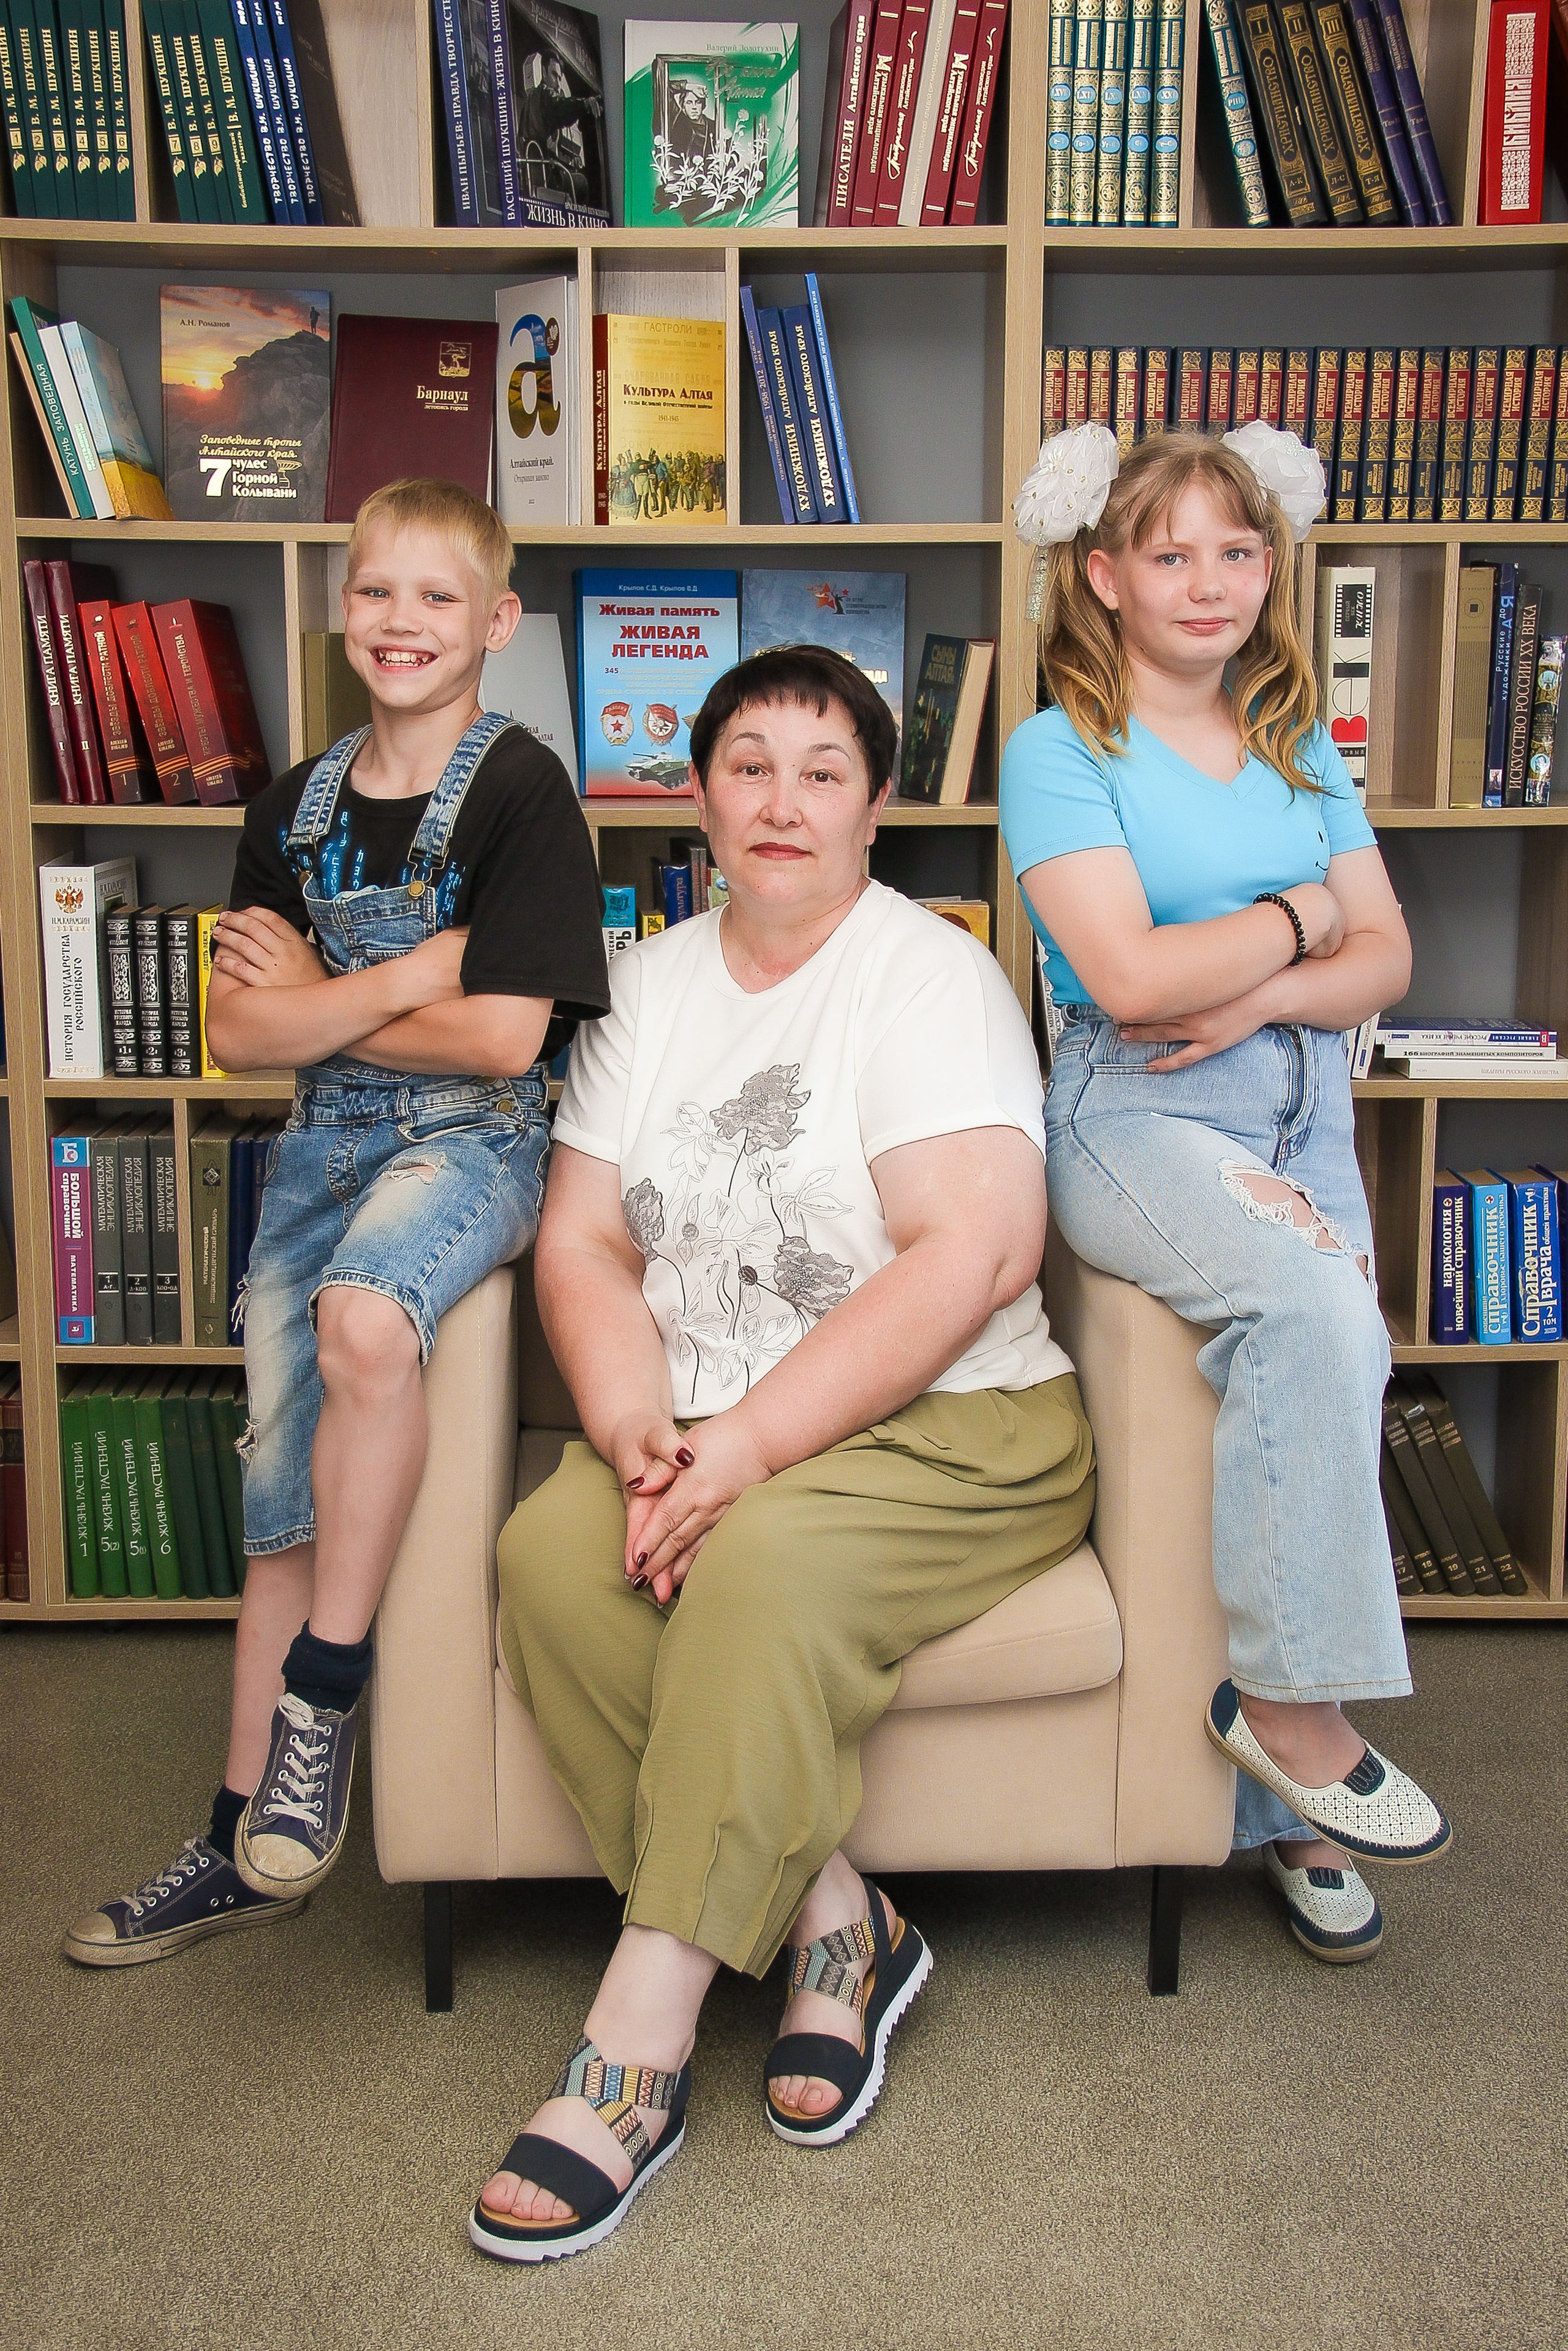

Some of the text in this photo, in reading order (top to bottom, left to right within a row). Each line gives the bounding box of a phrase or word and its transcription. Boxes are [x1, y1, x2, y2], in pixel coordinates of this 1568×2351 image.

[493, 33, 502, 43] В
[1326, 18, 1341, 33] III
[492, 45, 506, 91] ЖИЗНЬ
[706, 43, 779, 53] Валерий Золотухин
[19, 28, 40, 125] В. М. ШУКШИН
[41, 28, 62, 126] В. М. ШУКШИН
[68, 29, 85, 126] В. М. ШУКШИН
[246, 57, 265, 110] ШУКШИНА
[450, 71, 462, 119] ПРАВДА
[497, 91, 510, 159] ШУКШИН:
[835, 15, 866, 208] ПИСАТЕЛИ Алтайского края
[455, 121, 468, 175] ПЫРЬЕВ:
[263, 137, 284, 204] ТВОРЧЕСТВО
[502, 160, 516, 221] ВАСИЛИЙ
[1289, 176, 1303, 187] А-К
[1331, 174, 1346, 185] Л-С
[1365, 175, 1381, 186] Т-Я
[461, 179, 471, 211] ИВАН
[526, 203, 566, 227] ЖИЗНЬ
[567, 212, 576, 228] В
[198, 319, 231, 328] Романов
[644, 322, 692, 334] ГАСТРОЛИ
[416, 385, 469, 404] Барнаул
[623, 383, 713, 401] КУЛЬТУРА АЛТАЯ
[756, 369, 771, 410] 1958-2012
[1044, 371, 1055, 418] ВСЕМИРНАЯ
[1053, 376, 1062, 412] ИСТОРИЯ
[1066, 372, 1077, 418] ВСЕМИРНАЯ
[1076, 377, 1086, 412] ИСТОРИЯ
[1091, 372, 1101, 418] ВСЕМИРНАЯ
[1099, 377, 1109, 412] ИСТОРИЯ
[36, 363, 79, 476] КАТУНЬ ЗАПОВЕДНАЯ
[768, 330, 811, 512] ХУДОЖНИКИ АЛТАЙСКОГО КРАЯ
[795, 325, 836, 508] ХУДОЖНИКИ АЛТАЙСКОГО КРАЯ
[198, 445, 265, 457] Алтайского
[199, 434, 303, 449] Заповедные тропы
[509, 457, 539, 469] Алтайский
[199, 458, 232, 497] 7
[232, 459, 268, 474] чудес
[232, 470, 278, 486] Горной
[232, 485, 298, 499] Колывани
[598, 603, 721, 617] Живая память
[1355, 591, 1365, 630] КИНО
[1499, 595, 1514, 620] до Я
[611, 643, 710, 660] ЛЕГЕНДА
[619, 625, 700, 640] ЖИВАЯ
[1496, 630, 1506, 673] Русские
[37, 613, 61, 706] КНИГА ПАМЯТИ
[59, 613, 83, 706] КНИГА ПАМЯТИ
[175, 633, 192, 677] ГЕРОЙСТВА
[1501, 643, 1510, 701] художники
[94, 630, 121, 736] ЗВЁЗДЫ ДОБЛЕСТИ РАТНОЙ
[1509, 604, 1537, 790] ИСКУССТВО РОССИИ XX ВЕКА
[120, 774, 127, 787] 1
[171, 773, 181, 787] 2
[61, 934, 74, 1062] ИСТОРИЯ ГОСУДАРСТВА
[74, 957, 85, 1032] РОССИЙСКОГО
[70, 1172, 84, 1239] БОЛЬШОЙ
[96, 1155, 107, 1232] МАТЕМАТИЧЕСКАЯ
[105, 1155, 115, 1232] ЭНЦИКЛОПЕДИЯ
[124, 1157, 135, 1233] МАТЕМАТИЧЕСКАЯ
[134, 1157, 145, 1233] ЭНЦИКЛОПЕДИЯ
[156, 1157, 165, 1232] МАТЕМАТИЧЕСКАЯ
[165, 1157, 175, 1232] ЭНЦИКЛОПЕДИЯ
[70, 1255, 78, 1313] МАТЕМАТИКА
[121, 1438, 138, 1498] РАСТЕНИЙ
[72, 1441, 88, 1557] 1 ЖИЗНЬ РАСТЕНИЙ
[94, 1430, 120, 1552] 5(2) ЖИЗНЬ РАСТЕНИЙ
[147, 1441, 172, 1555] 6 ЖИЗНЬ РАСТЕНИЙ
[129, 1498, 142, 1537] ЖИЗНЬ
[1396, 1566, 1406, 1576] 17
[1421, 1560, 1433, 1569] 18
[1447, 1563, 1458, 1572] 19
[1474, 1565, 1487, 1574] 21
[1500, 1563, 1512, 1572] 22
